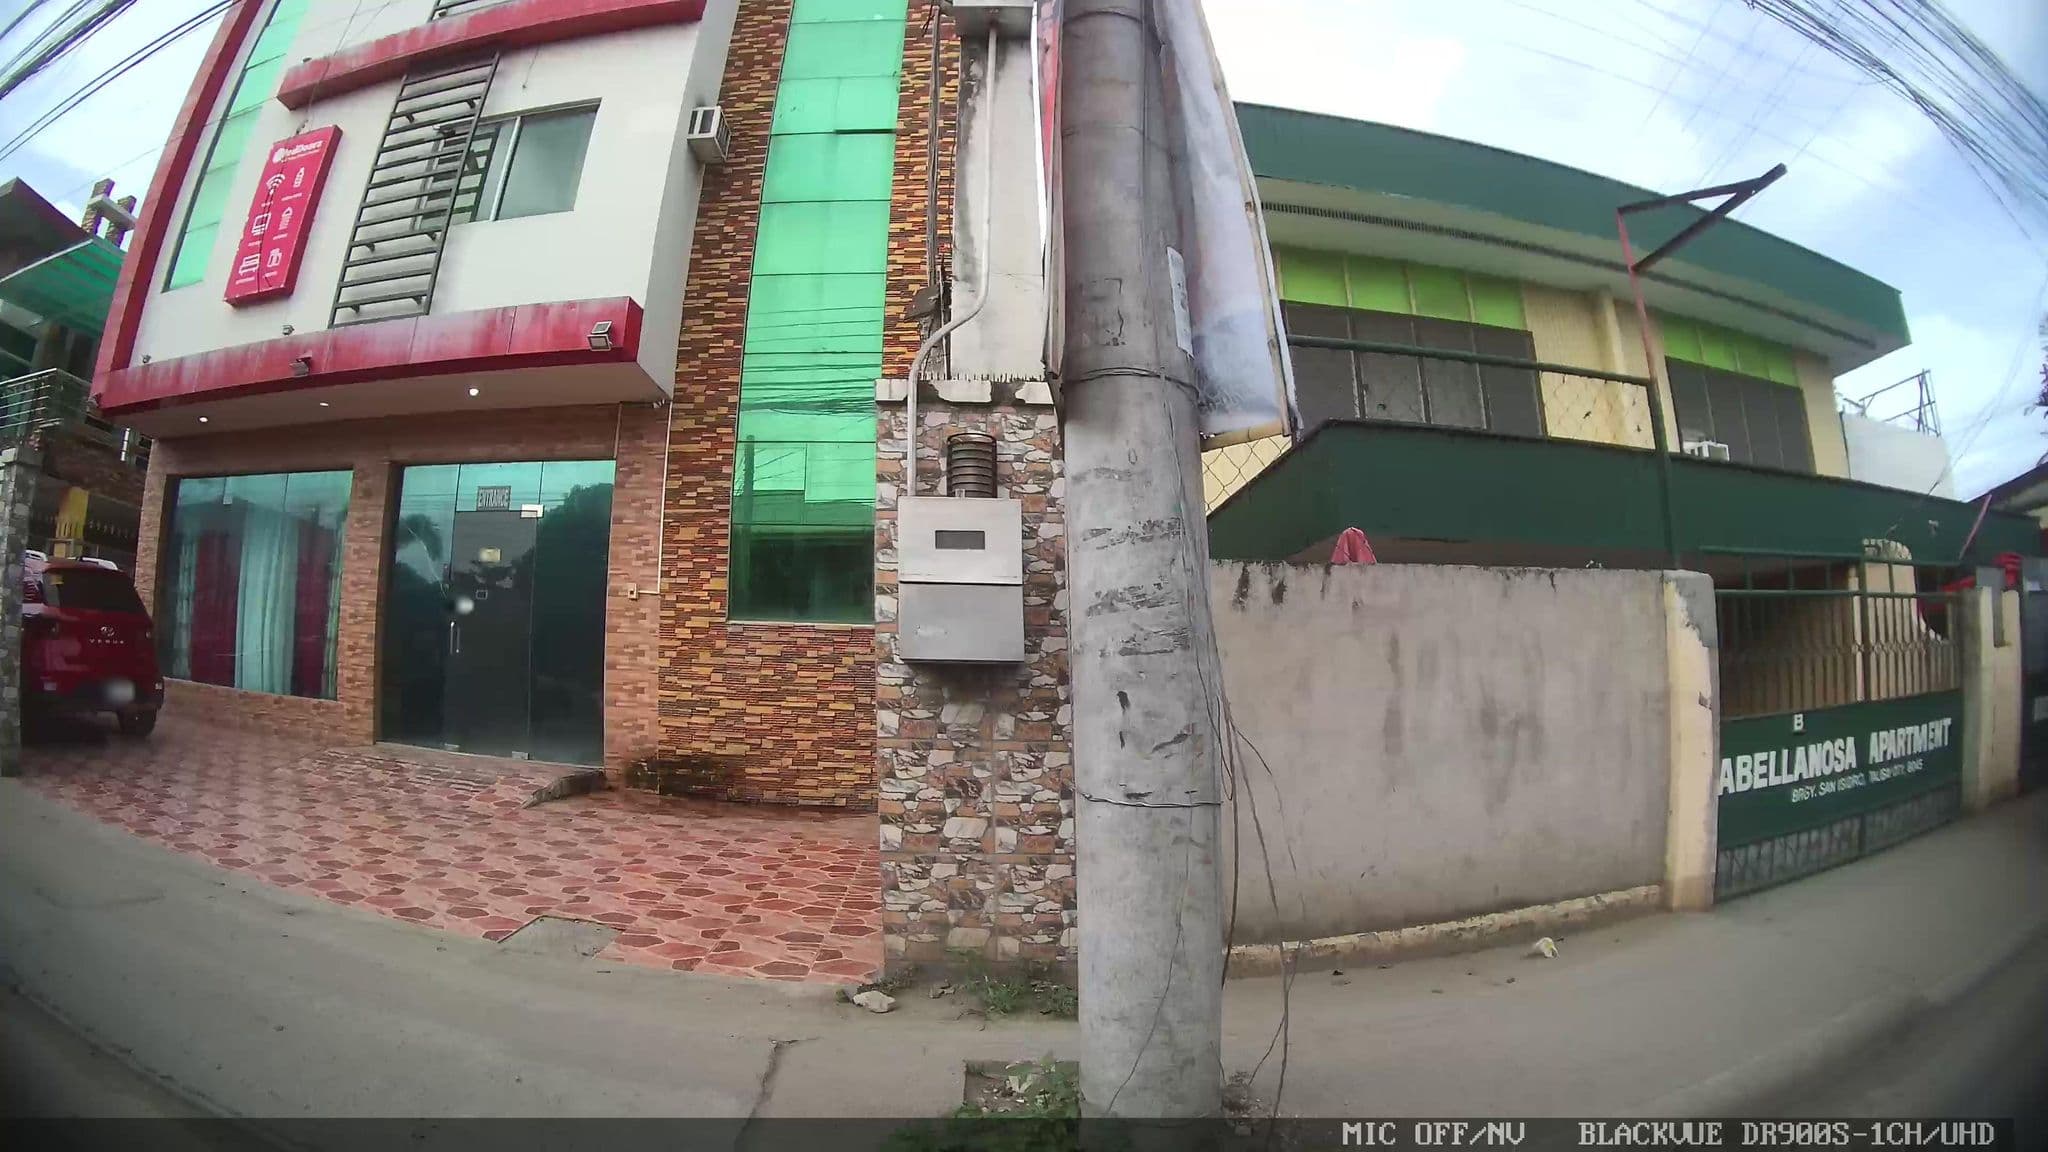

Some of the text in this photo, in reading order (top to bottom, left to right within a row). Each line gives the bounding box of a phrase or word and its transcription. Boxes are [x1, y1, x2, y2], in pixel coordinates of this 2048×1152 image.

[478, 488, 509, 507] ENTRANCE
[1793, 713, 1804, 731] B
[1718, 717, 1952, 796] ABELLANOSA APARTMENT
[1819, 780, 1836, 796] SAN
